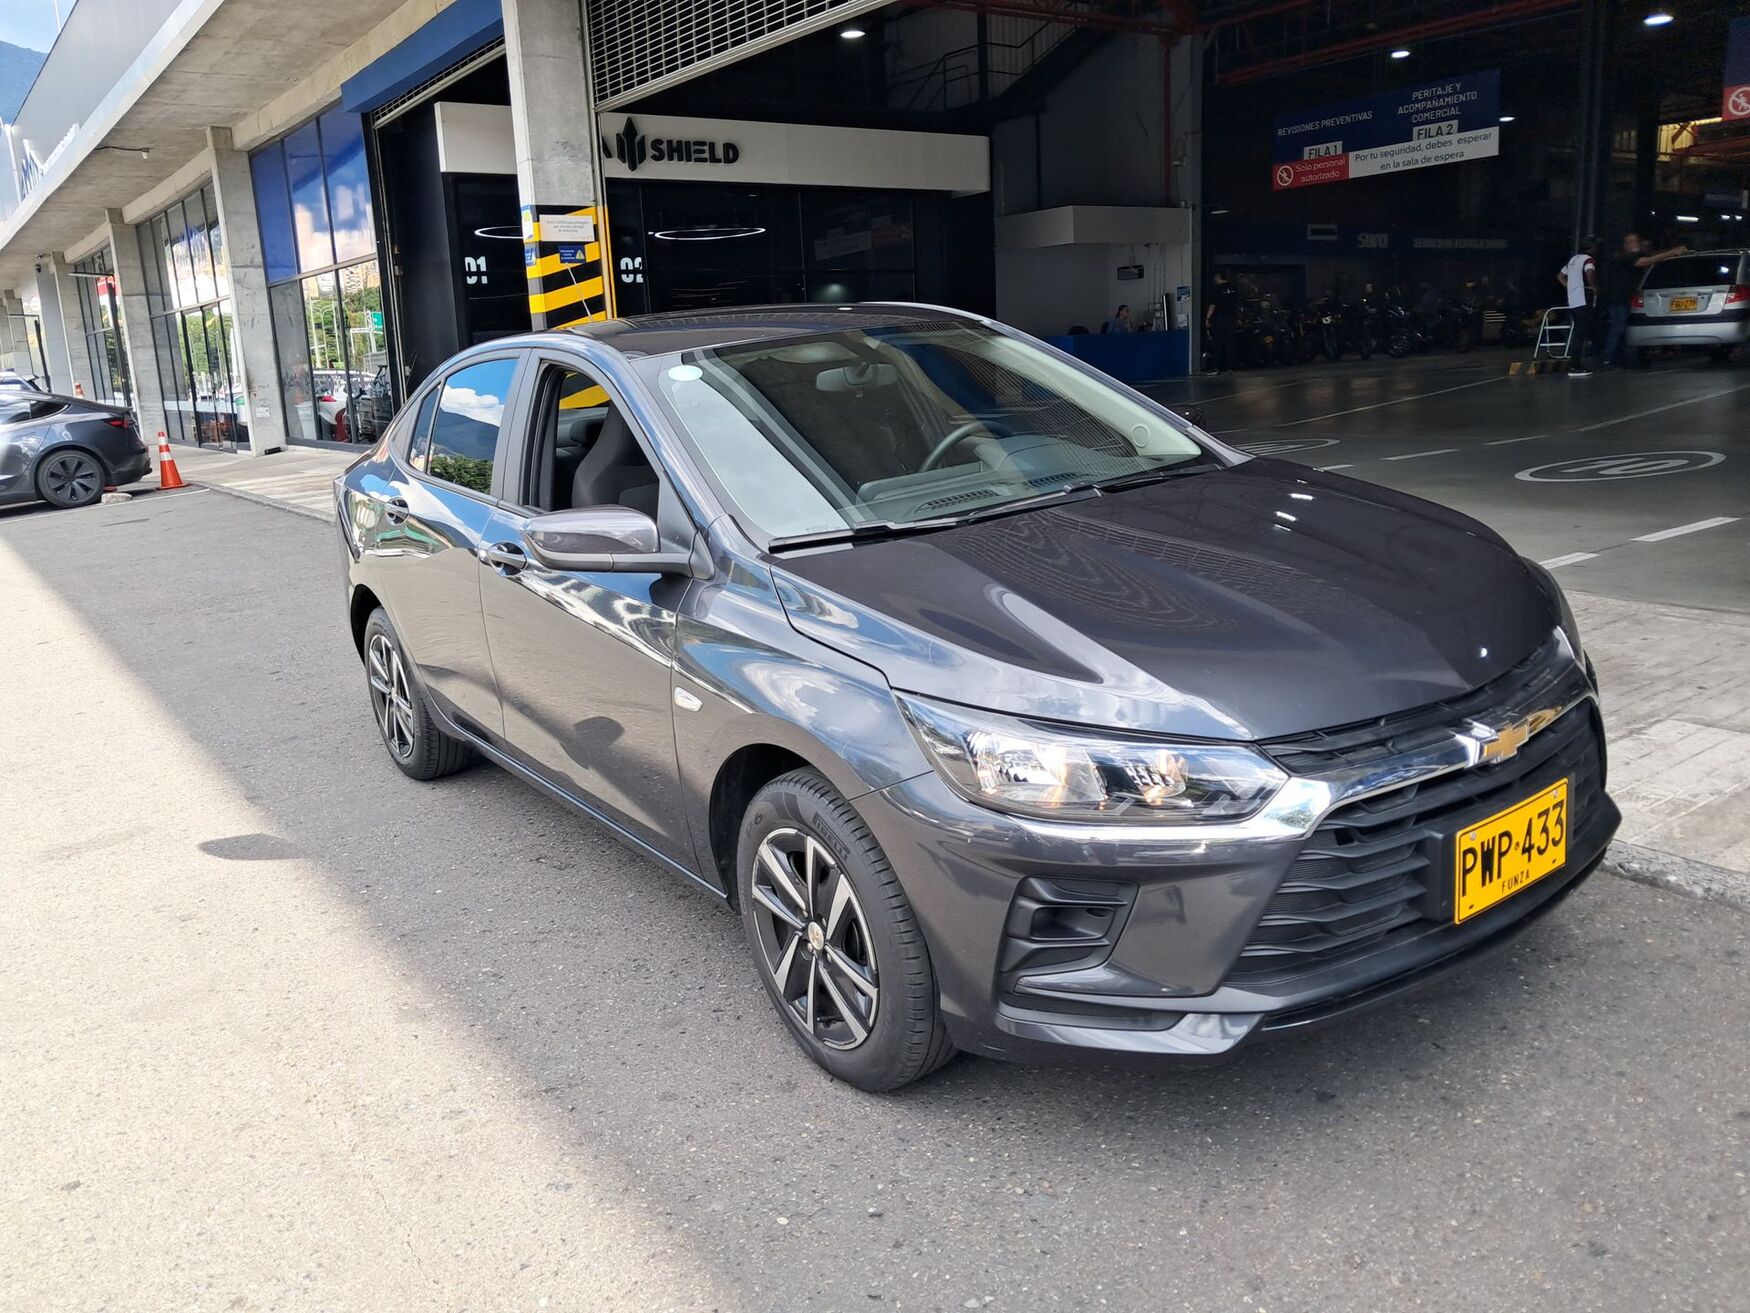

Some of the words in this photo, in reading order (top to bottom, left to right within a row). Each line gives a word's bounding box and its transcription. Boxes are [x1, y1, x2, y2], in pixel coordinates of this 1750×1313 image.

[1412, 83, 1455, 101] PERITAJE
[1456, 82, 1462, 91] Y
[1397, 91, 1478, 115] ACOMPAÑAMIENTO
[1277, 121, 1320, 137] REVISIONES
[1320, 111, 1373, 128] PREVENTIVAS
[1412, 106, 1462, 123] COMERCIAL
[1417, 125, 1444, 141] FILA
[1446, 123, 1454, 136] 2
[650, 138, 740, 164] SHIELD
[1308, 145, 1331, 159] FILA
[1333, 144, 1338, 155] 1
[1354, 153, 1368, 162] Por
[1370, 151, 1378, 160] tu
[1379, 143, 1424, 159] seguridad,
[1425, 139, 1453, 151] debes
[1456, 132, 1492, 146] esperar
[1295, 163, 1312, 173] Solo
[1313, 156, 1346, 171] personal
[1380, 163, 1392, 172] en
[1393, 160, 1401, 169] la
[1402, 157, 1419, 168] sala
[1420, 154, 1433, 165] de
[1433, 151, 1465, 164] espera
[1301, 170, 1340, 183] autorizado
[464, 255, 488, 285] 01
[620, 256, 644, 284] 02
[1501, 868, 1531, 893] FUNZA
